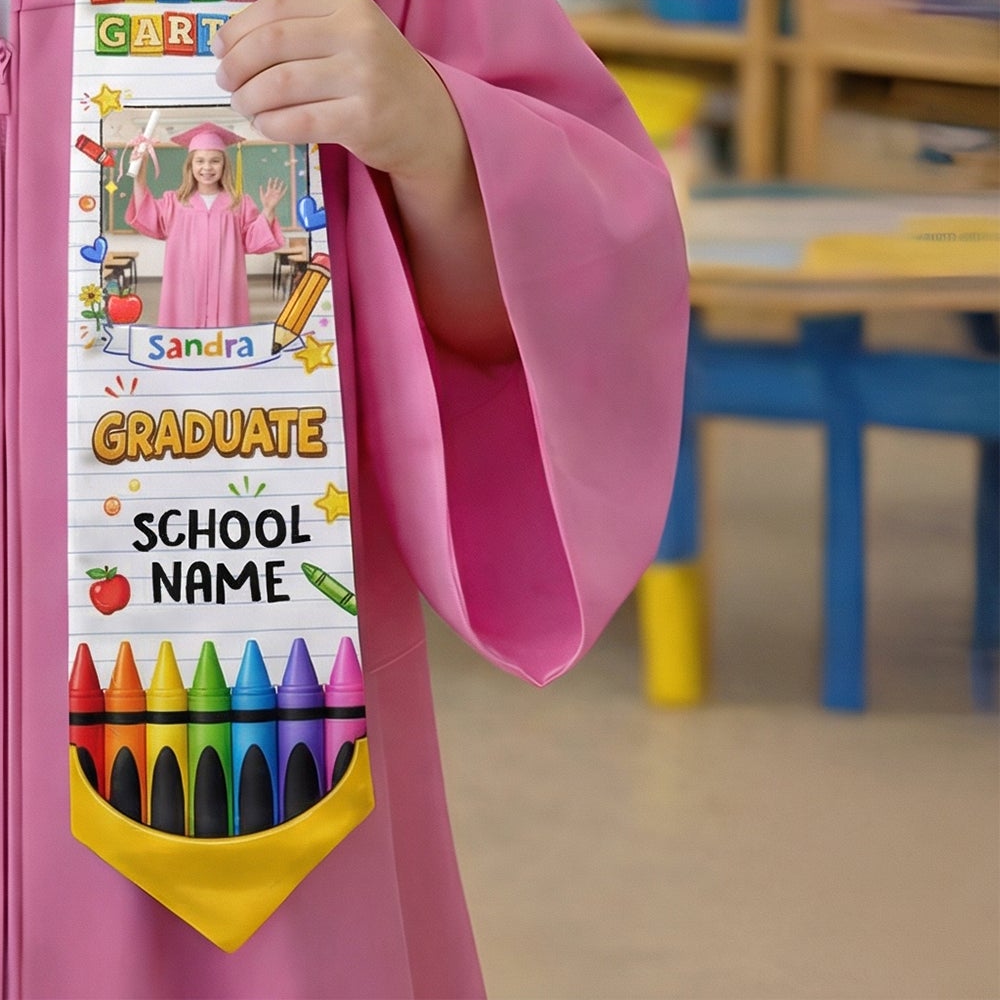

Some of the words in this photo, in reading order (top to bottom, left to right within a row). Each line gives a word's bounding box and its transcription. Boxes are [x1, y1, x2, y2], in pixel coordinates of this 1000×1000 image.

[98, 14, 225, 48] GART
[148, 331, 255, 361] Sandra
[92, 406, 328, 466] GRADUATE
[131, 504, 312, 553] SCHOOL
[151, 560, 291, 605] NAME
